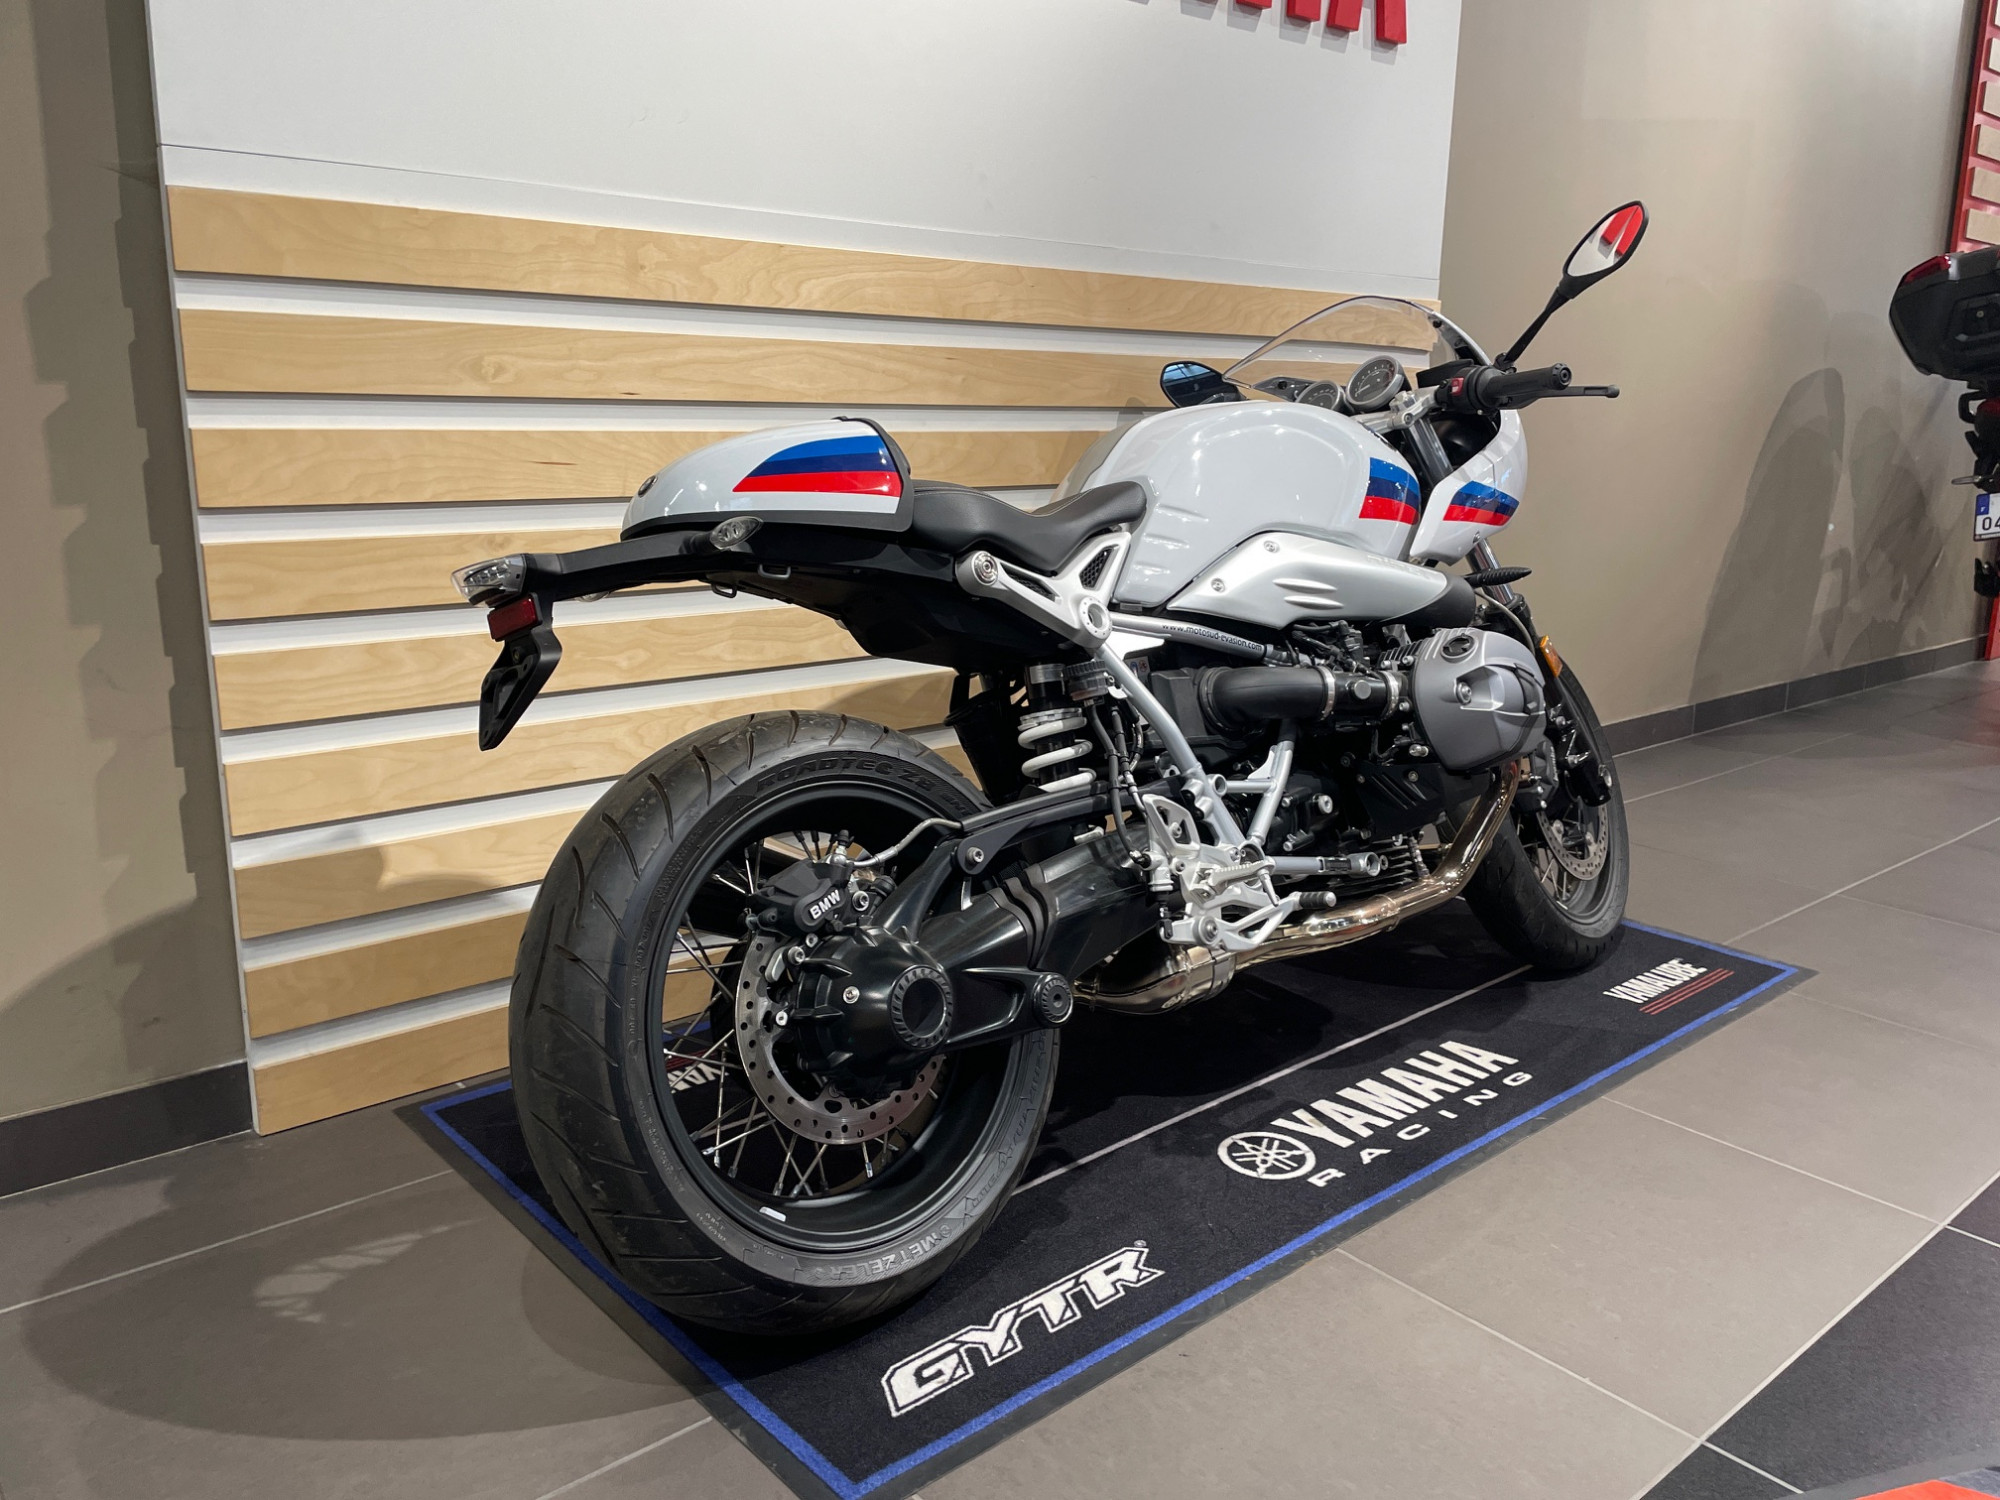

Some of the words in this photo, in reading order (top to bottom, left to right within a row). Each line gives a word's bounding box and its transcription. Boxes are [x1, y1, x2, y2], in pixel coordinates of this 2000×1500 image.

[1162, 624, 1263, 651] www.motosud-evasion.com
[810, 889, 840, 919] BMW
[1602, 958, 1708, 1004] YAMALUBE
[1269, 1040, 1519, 1148] YAMAHA
[1307, 1071, 1533, 1187] RACING
[828, 1232, 941, 1281] METZELER
[881, 1246, 1166, 1418] GYTR
